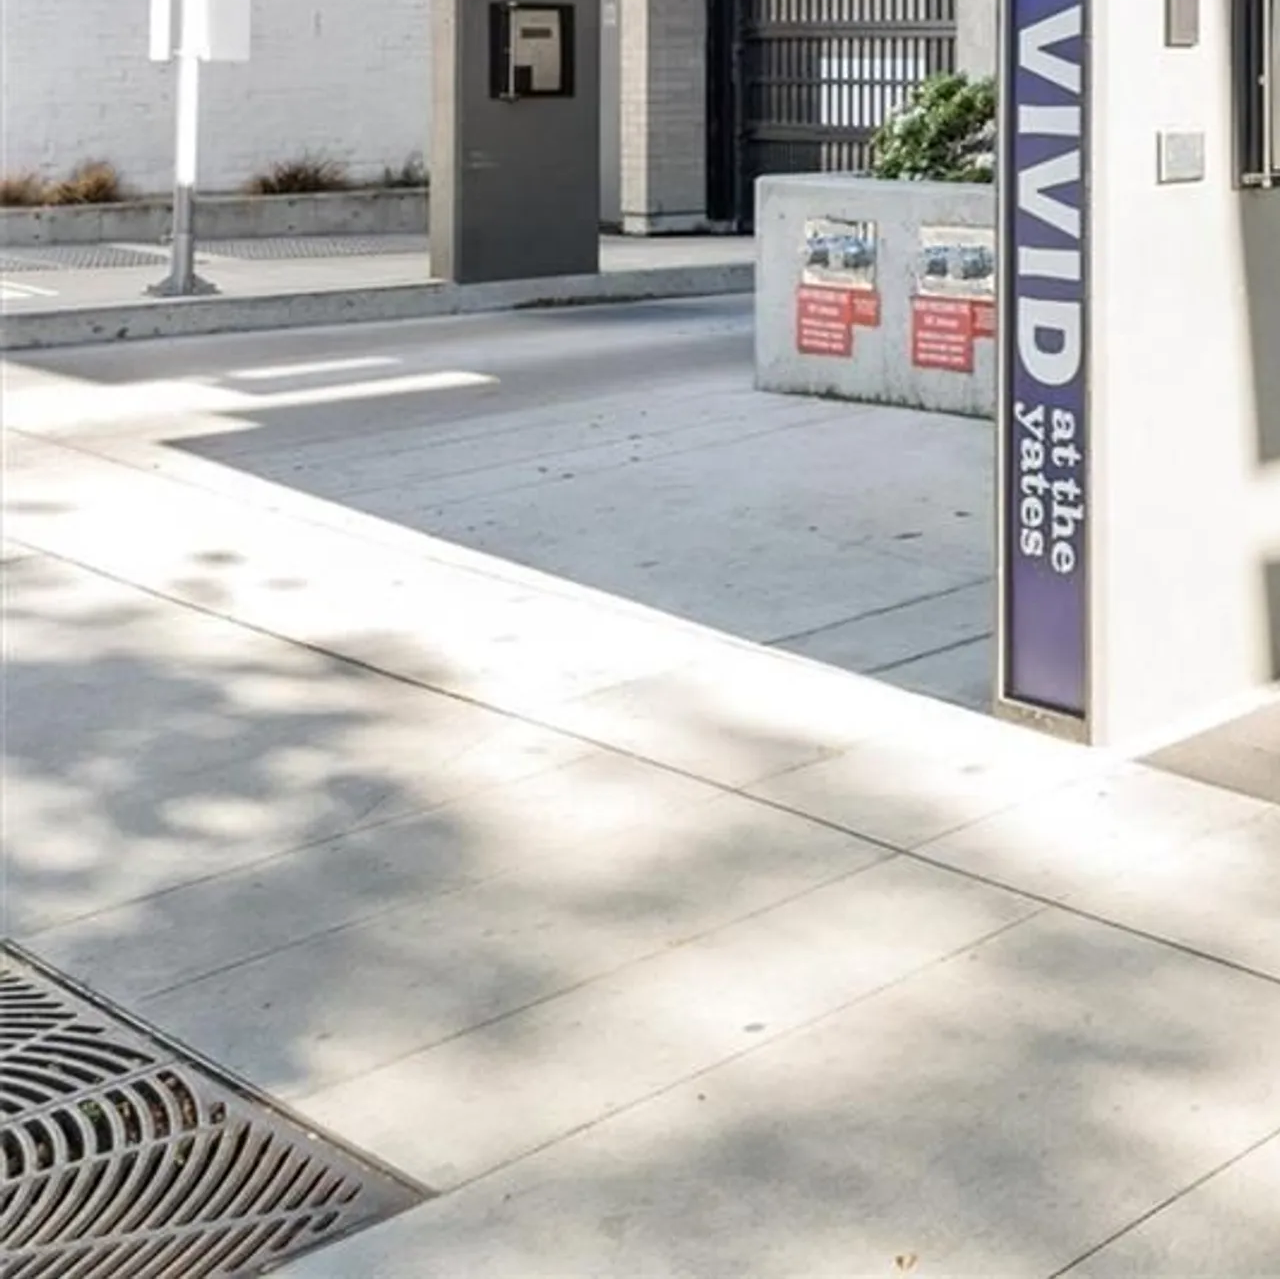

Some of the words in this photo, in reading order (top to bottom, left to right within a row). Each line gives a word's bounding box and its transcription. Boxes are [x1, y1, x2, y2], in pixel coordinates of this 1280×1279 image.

[1017, 4, 1082, 387] VIVID
[1013, 402, 1050, 557] yates
[1052, 408, 1082, 467] at
[1051, 478, 1084, 573] the
